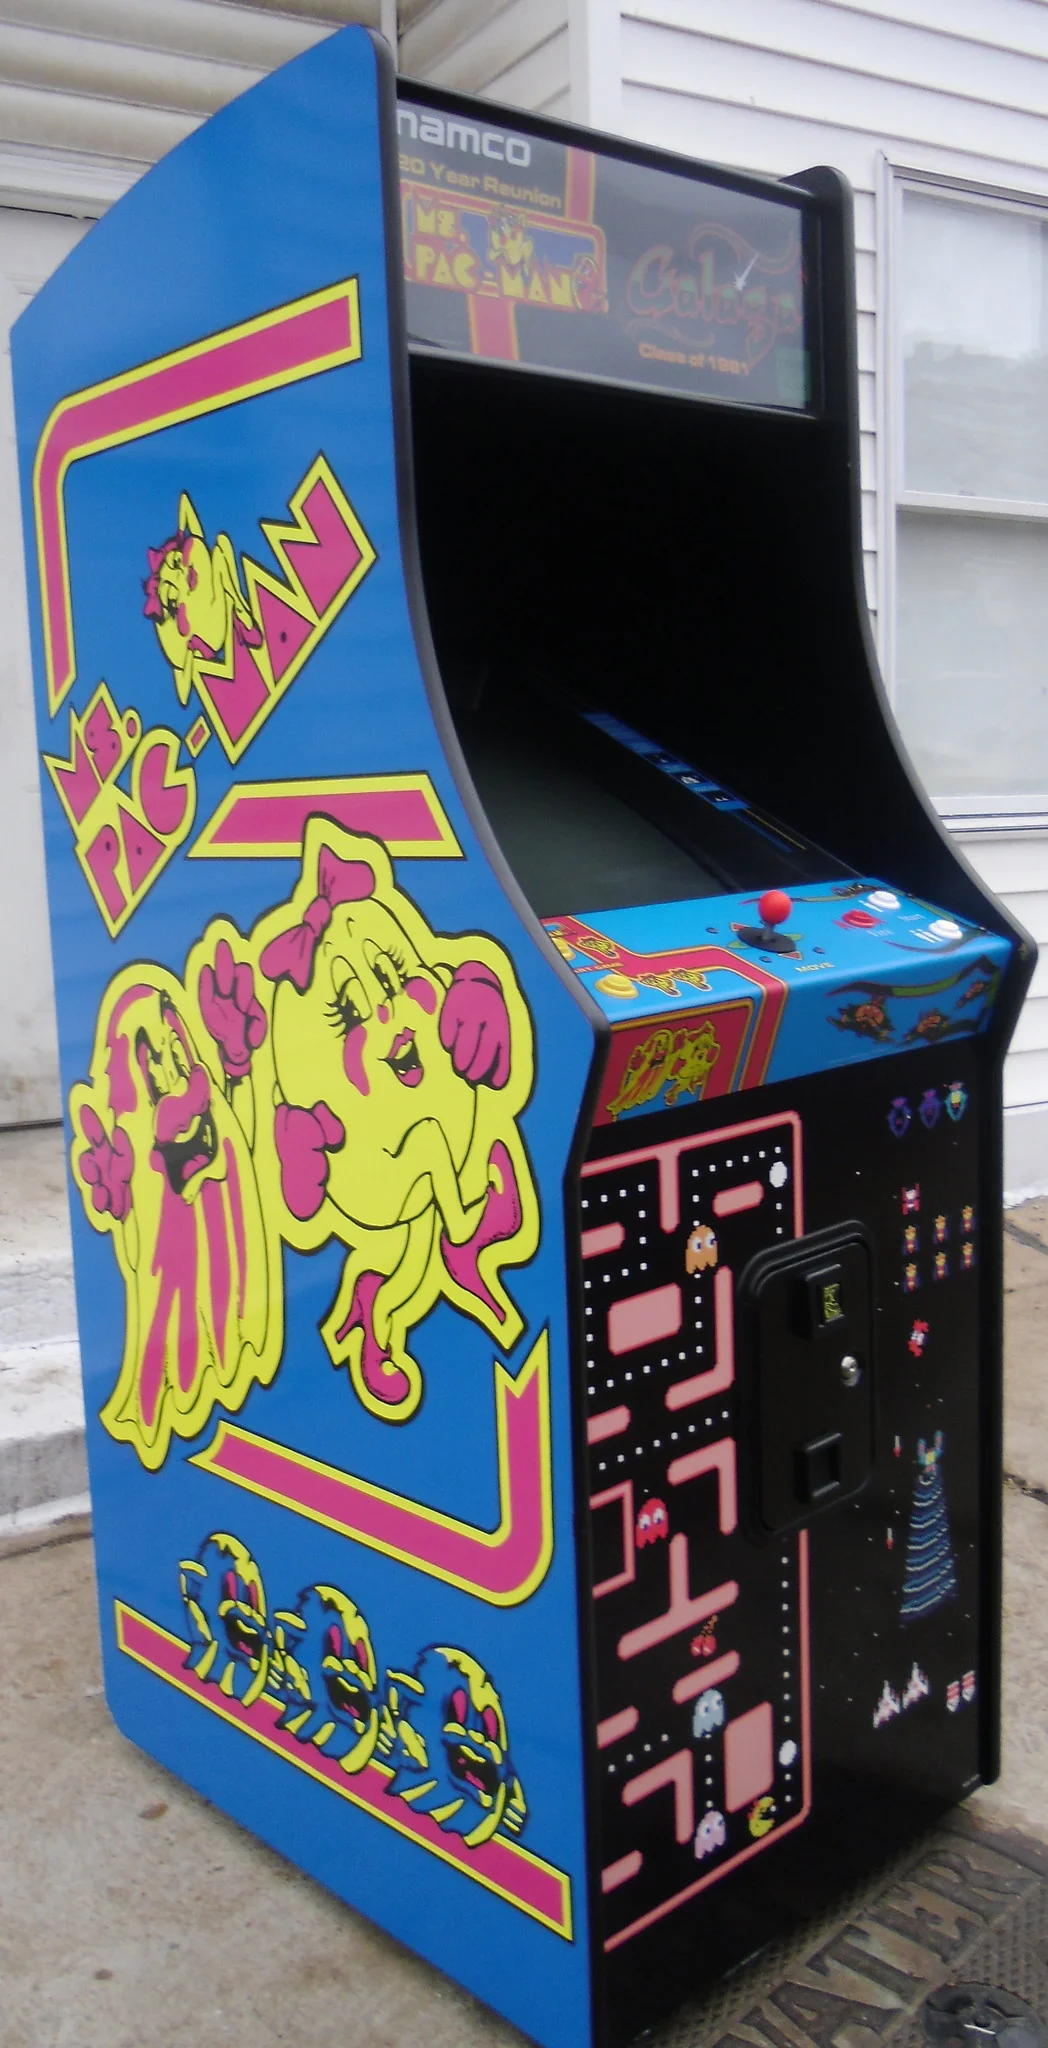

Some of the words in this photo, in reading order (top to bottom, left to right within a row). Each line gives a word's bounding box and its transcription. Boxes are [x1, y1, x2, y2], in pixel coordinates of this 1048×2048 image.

[396, 109, 532, 168] namco
[398, 153, 426, 177] 20
[429, 160, 481, 188] Year
[483, 175, 562, 209] Reunion
[413, 242, 574, 308] PAC-MAN
[638, 342, 687, 365] Class
[689, 353, 706, 369] of
[707, 356, 751, 376] 1981
[794, 961, 836, 974] MOVE
[712, 1849, 1040, 2048] ATER
